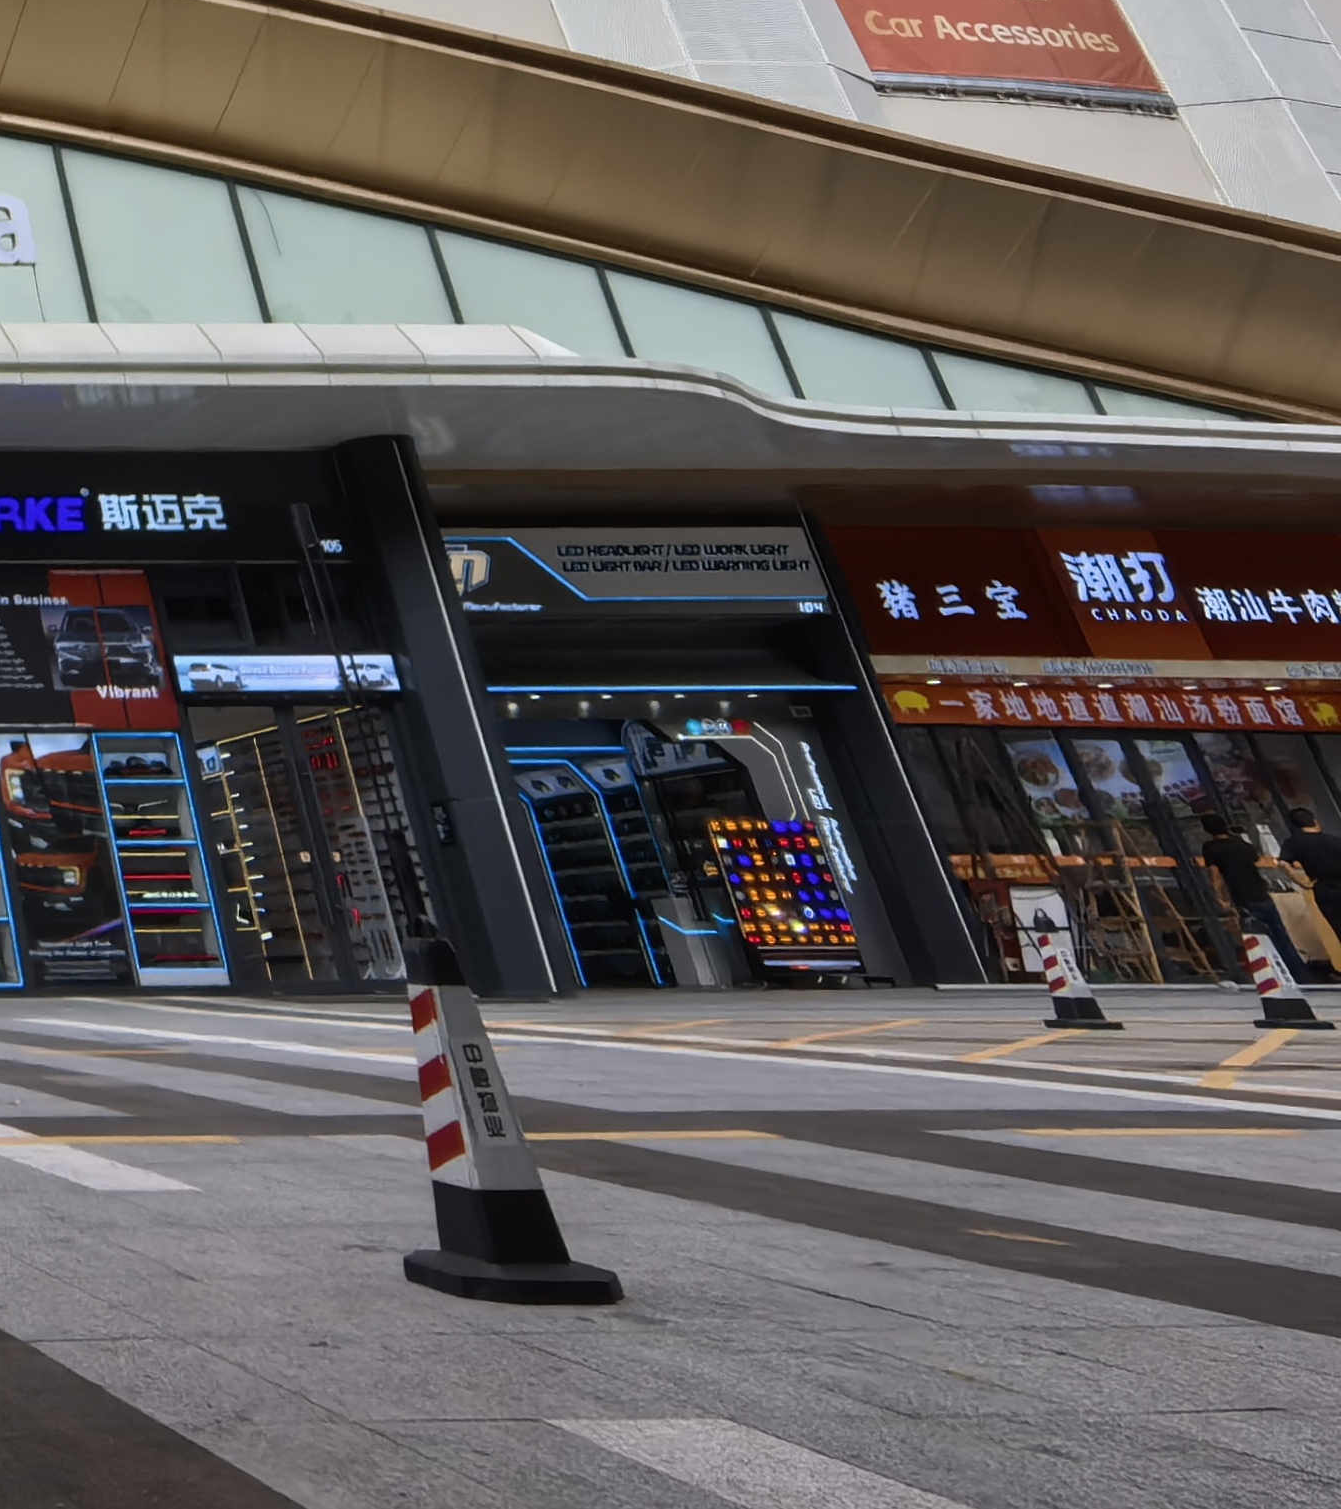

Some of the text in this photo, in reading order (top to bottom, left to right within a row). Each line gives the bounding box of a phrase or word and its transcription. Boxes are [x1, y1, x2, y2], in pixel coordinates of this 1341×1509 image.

[864, 10, 1120, 53] Car Accessories
[97, 493, 228, 531] 斯迈克
[320, 539, 343, 553] 105
[557, 545, 584, 557] LED
[674, 544, 701, 556] LED
[562, 561, 589, 572] LED
[673, 560, 699, 572] LED
[1059, 551, 1176, 603] 潮打
[799, 601, 824, 613] 104
[875, 579, 1029, 621] 猪三宝
[1091, 608, 1190, 622] CHAODA
[96, 685, 159, 700] Vibrant
